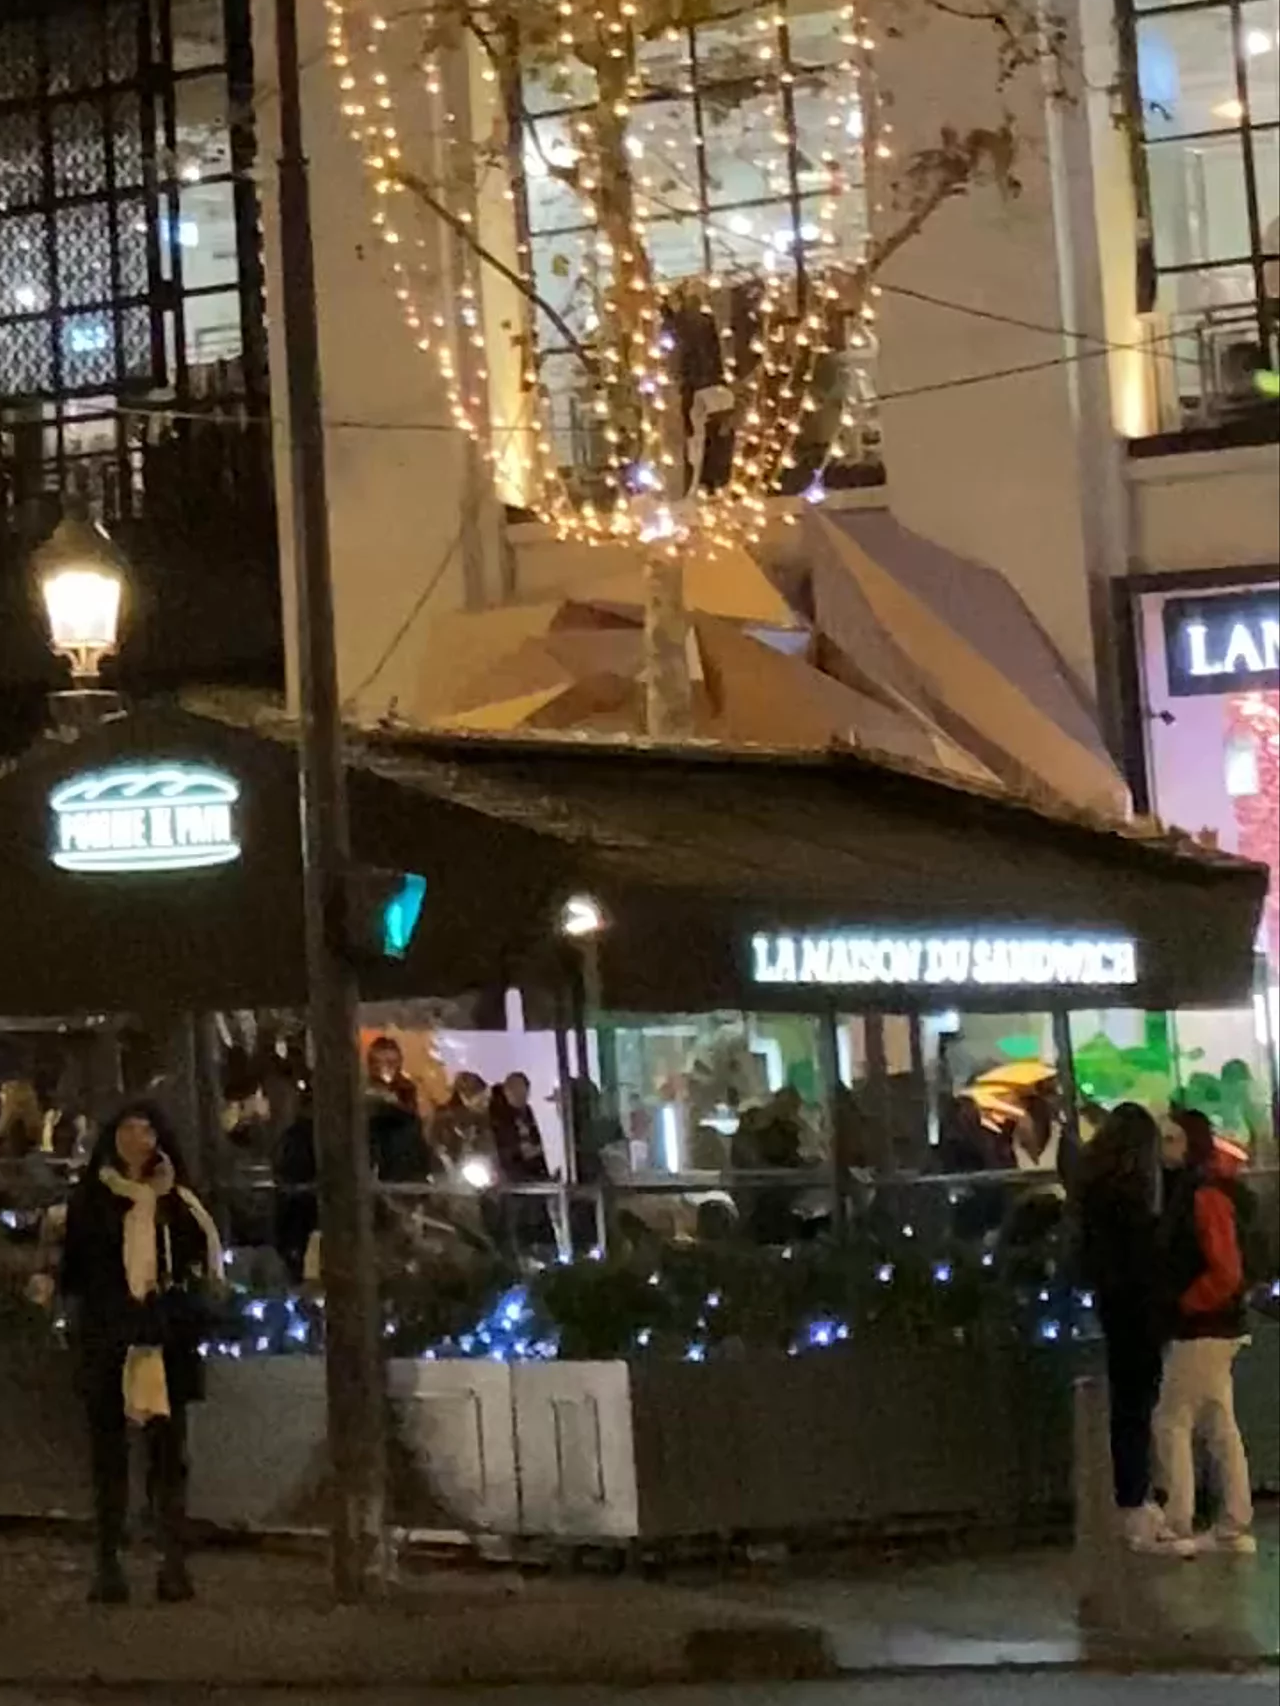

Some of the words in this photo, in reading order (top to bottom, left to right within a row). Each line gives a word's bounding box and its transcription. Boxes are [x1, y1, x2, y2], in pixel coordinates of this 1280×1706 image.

[752, 932, 797, 983] LA
[799, 937, 923, 984] MAISON
[924, 938, 970, 984] DU
[972, 938, 1138, 984] SANDWICH
